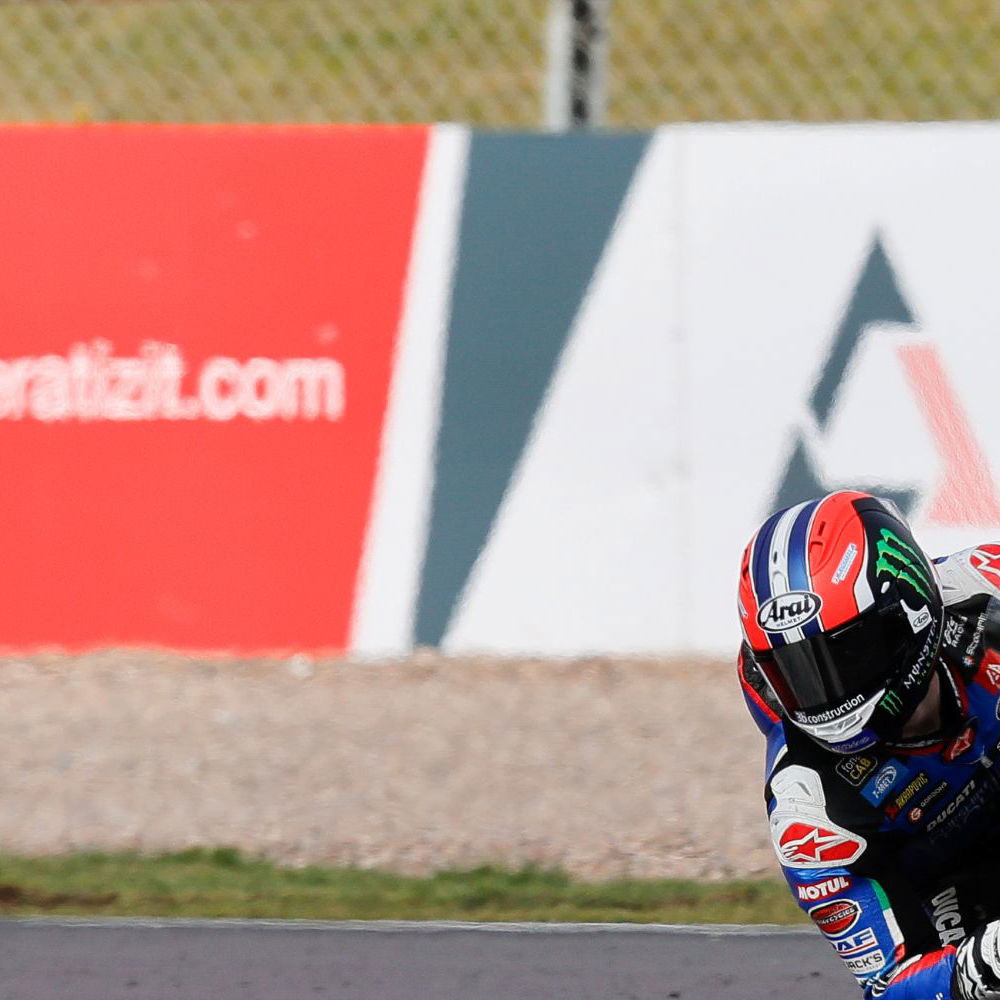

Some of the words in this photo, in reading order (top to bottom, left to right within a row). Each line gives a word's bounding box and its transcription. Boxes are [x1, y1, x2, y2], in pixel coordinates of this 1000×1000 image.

[761, 594, 812, 622] Arai
[808, 694, 865, 724] construction
[850, 758, 872, 780] CAB
[927, 780, 976, 832] DUCATI
[797, 876, 849, 900] MOTUL
